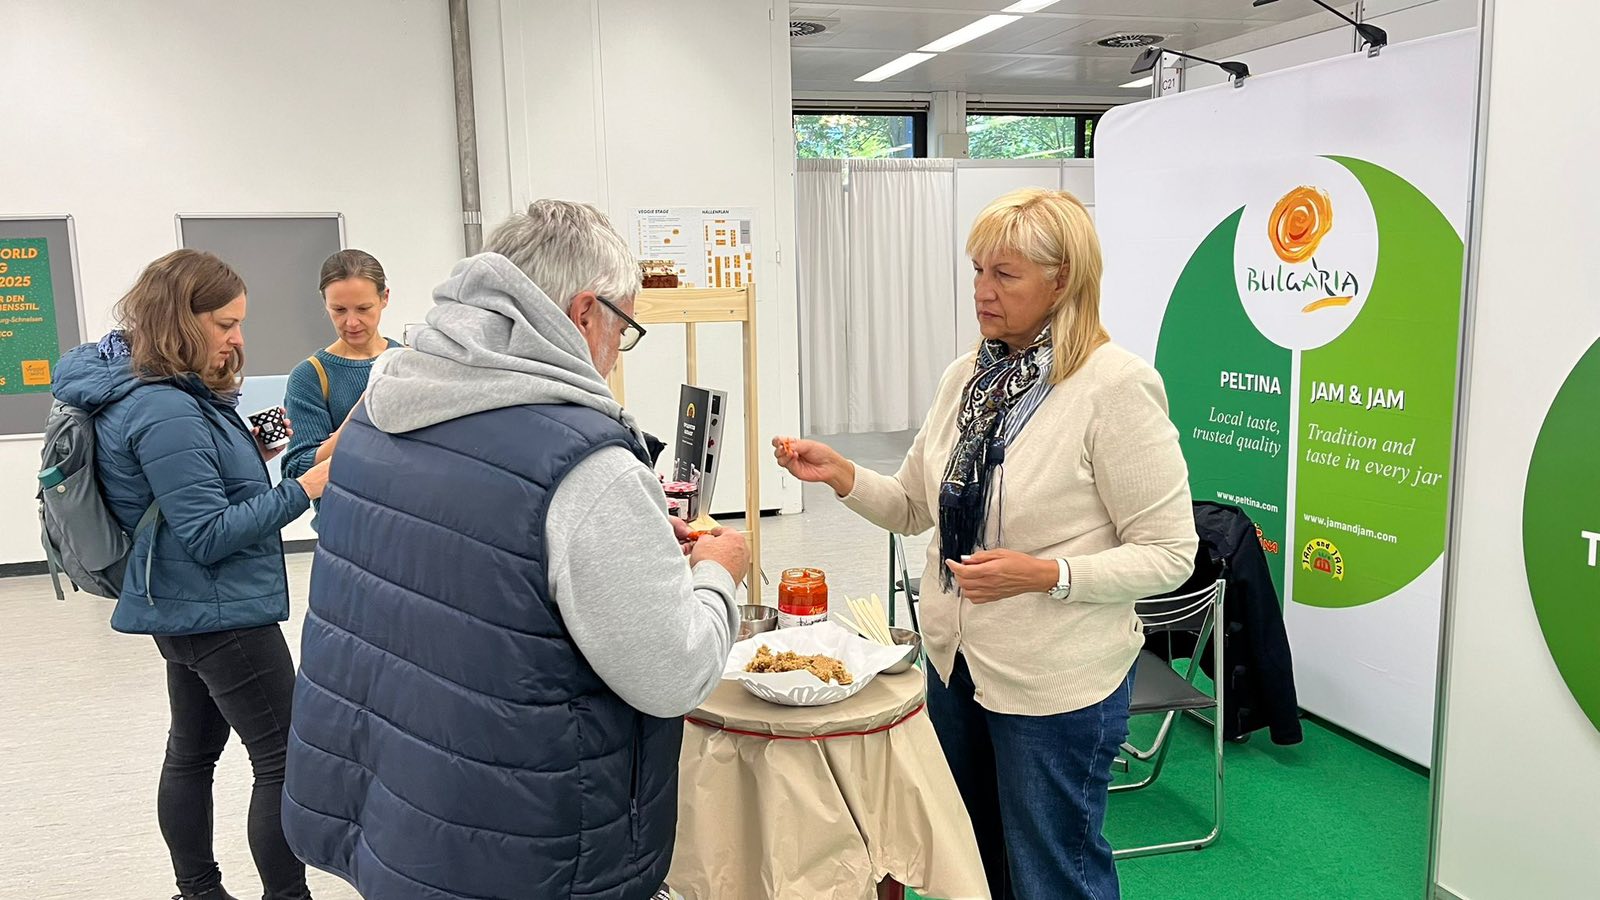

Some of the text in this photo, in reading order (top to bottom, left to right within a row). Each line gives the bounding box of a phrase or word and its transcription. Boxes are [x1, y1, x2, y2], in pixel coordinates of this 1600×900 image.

[1162, 78, 1176, 91] C21
[0, 247, 38, 260] ORLD
[1247, 257, 1359, 297] BULGARIA
[6, 294, 25, 303] DEN
[1220, 371, 1282, 395] PELTINA
[1310, 380, 1405, 410] JAM & JAM
[1209, 406, 1280, 435] Local taste,
[1193, 426, 1281, 458] trusted quality
[1308, 423, 1416, 456] Tradition and
[1306, 448, 1443, 487] taste in every jar
[1216, 490, 1279, 513] www.peltina.com
[1303, 513, 1398, 543] www.jamandjam.com
[1302, 543, 1315, 565] JAM
[1331, 550, 1343, 575] JAM
